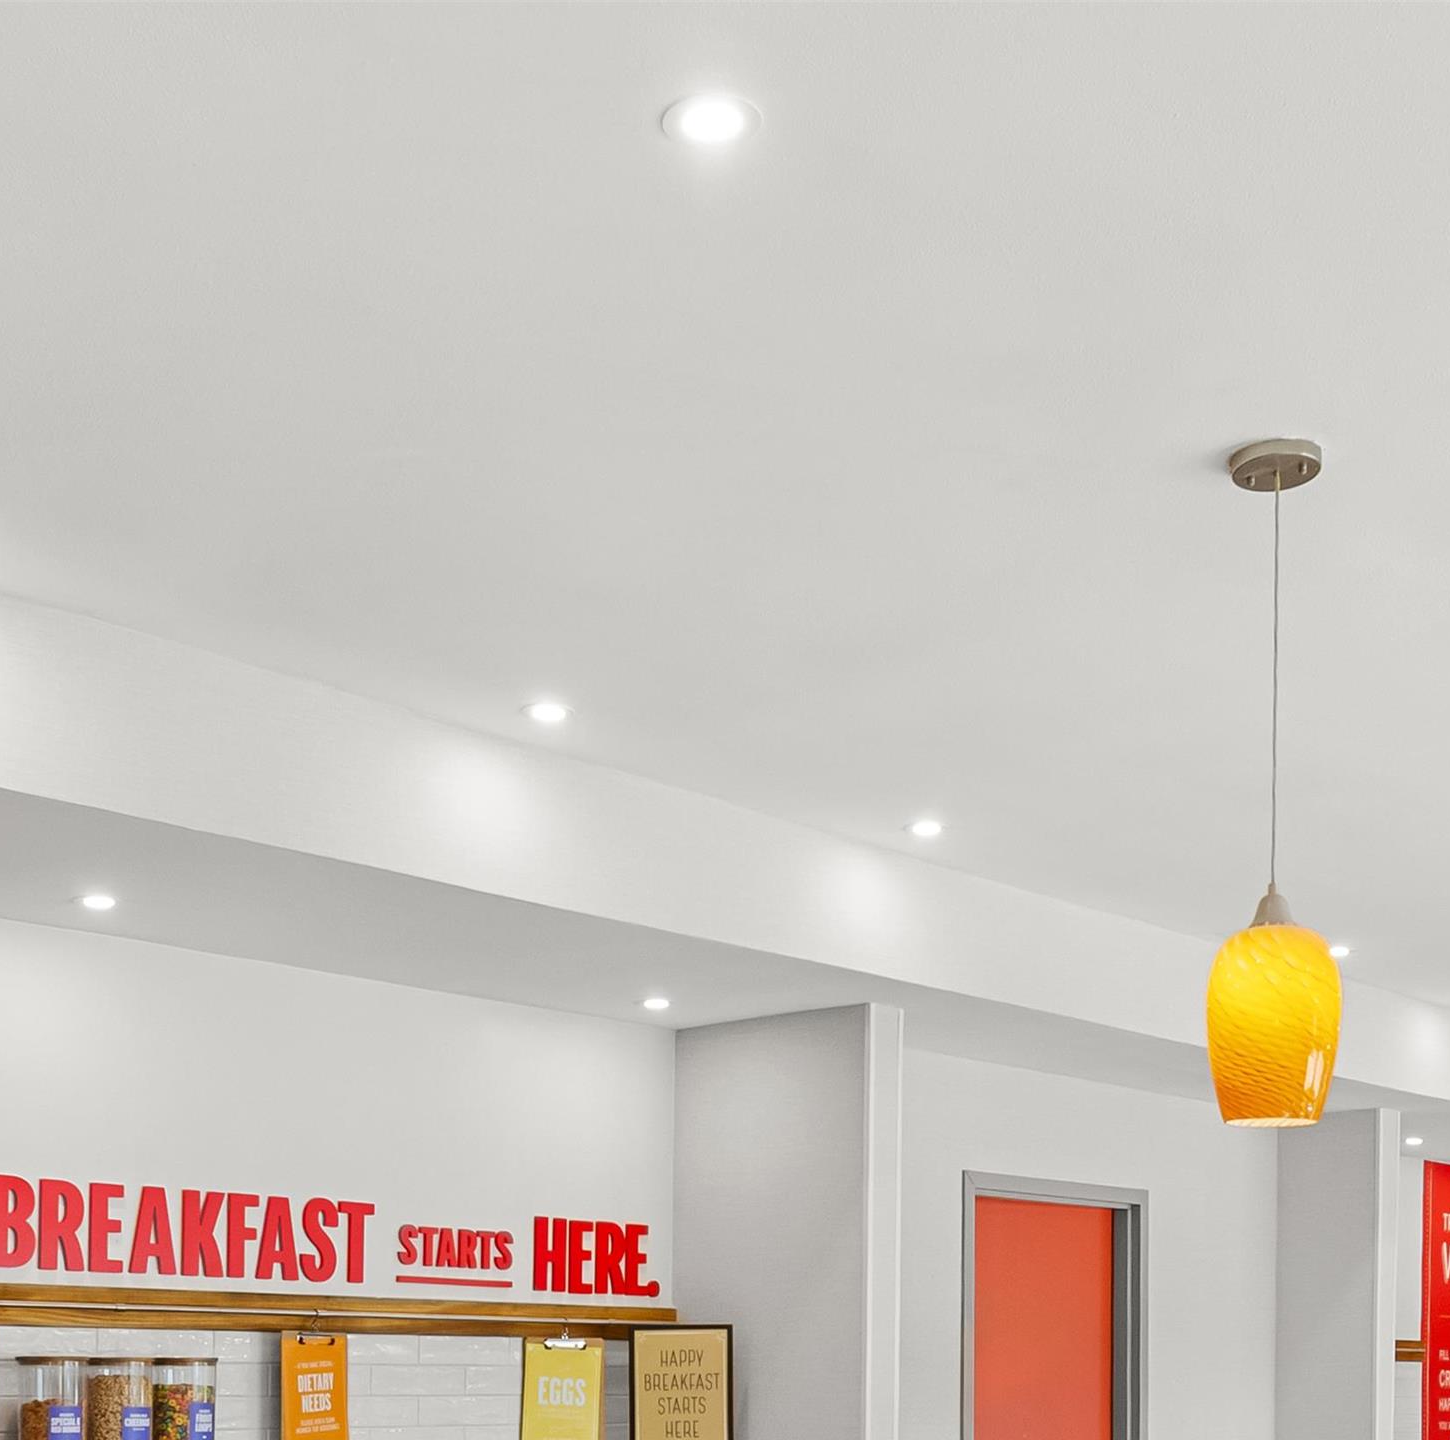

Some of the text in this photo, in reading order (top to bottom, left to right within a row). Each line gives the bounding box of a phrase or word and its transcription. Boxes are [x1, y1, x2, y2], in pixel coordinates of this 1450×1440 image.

[397, 1224, 514, 1270] STARTS
[532, 1216, 660, 1297] HERE.
[660, 1349, 704, 1367] HAPPY
[297, 1372, 334, 1393] DIETARY
[537, 1375, 587, 1407] EGGS
[644, 1373, 720, 1391] BREAKFAST
[301, 1392, 332, 1413] NEEDS
[657, 1396, 707, 1415] STARTS
[665, 1420, 700, 1438] HERE
